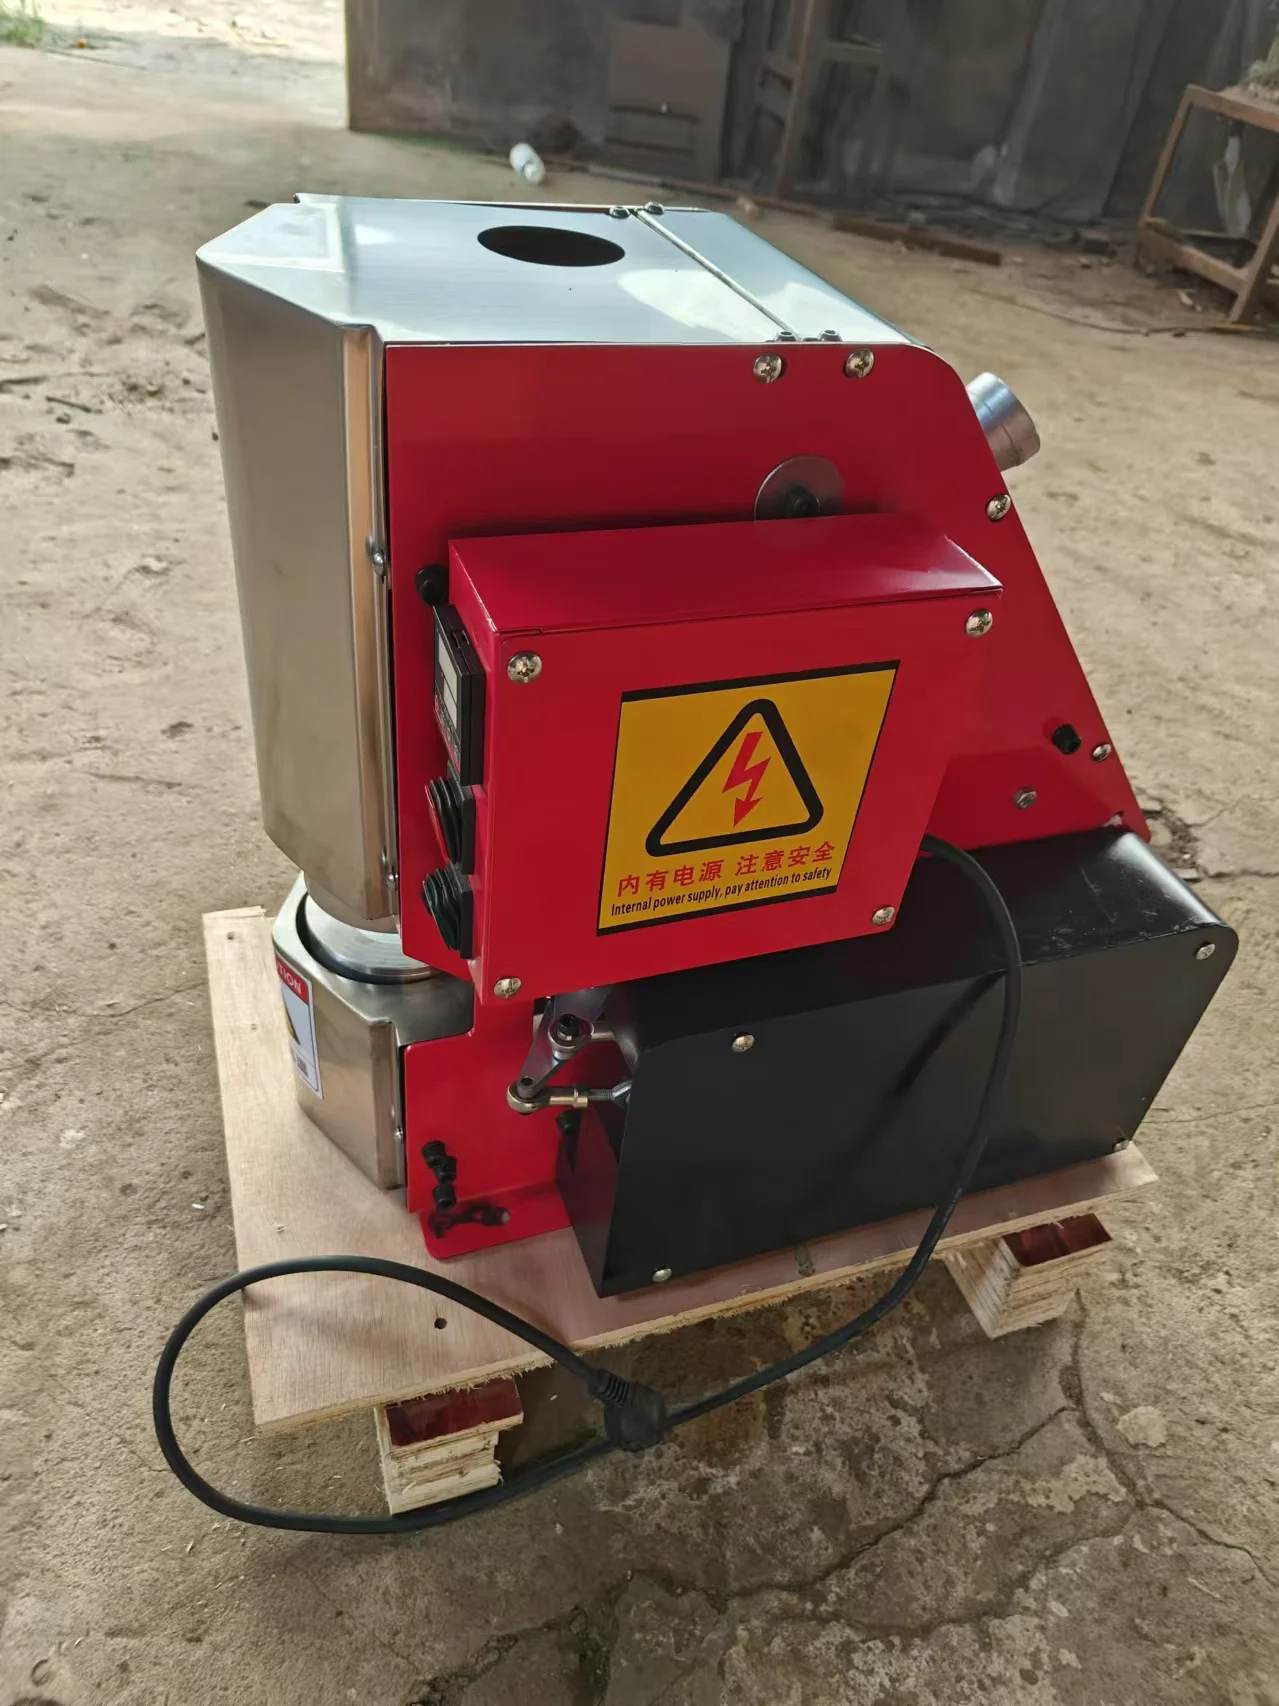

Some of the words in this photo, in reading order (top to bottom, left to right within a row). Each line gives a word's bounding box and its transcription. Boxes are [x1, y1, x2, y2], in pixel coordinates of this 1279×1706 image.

[611, 896, 652, 916] Internal
[653, 894, 686, 911] power
[687, 885, 723, 903] supply,
[724, 883, 744, 898] pay
[744, 874, 789, 892] attention
[791, 871, 801, 883] to
[802, 866, 833, 881] safety
[617, 859, 725, 897] 内有电源
[735, 840, 835, 876] 注意安全
